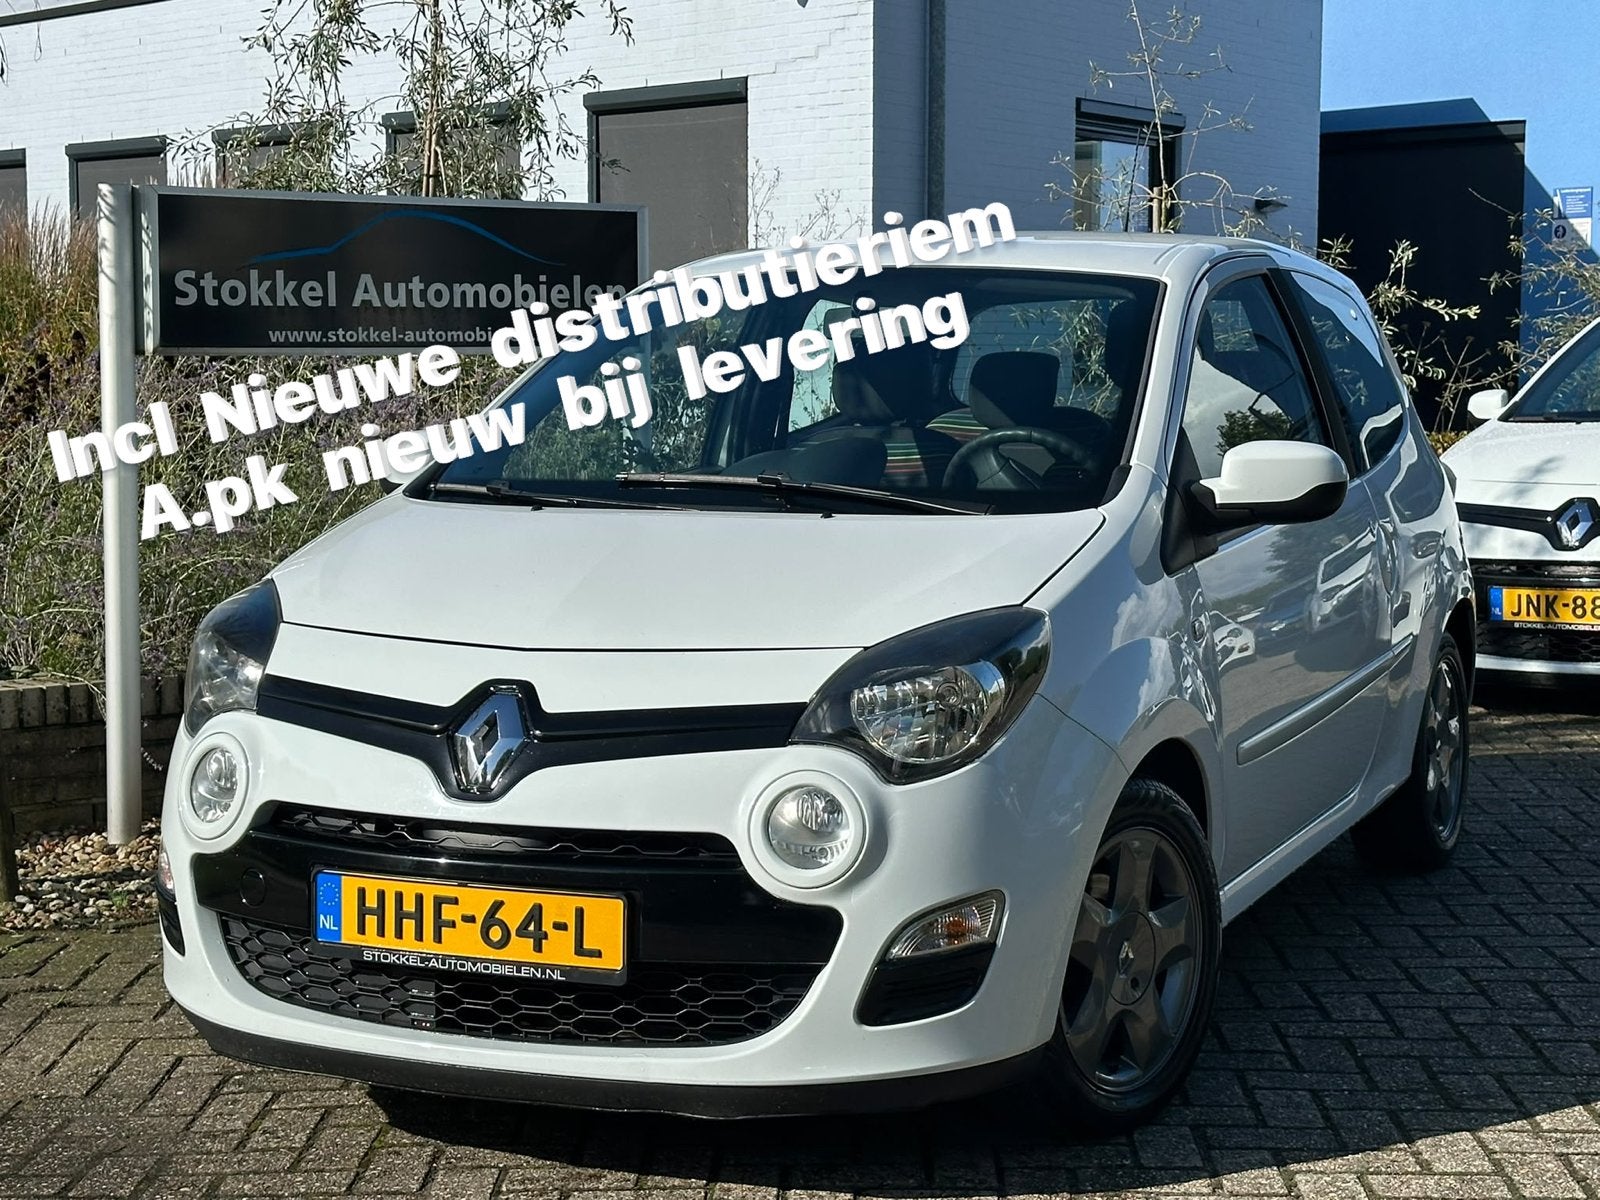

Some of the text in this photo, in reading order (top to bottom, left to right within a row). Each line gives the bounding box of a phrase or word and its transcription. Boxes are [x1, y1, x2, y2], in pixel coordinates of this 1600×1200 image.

[173, 269, 337, 308] Stokkel
[268, 327, 512, 345] www.stokkel-automobi
[1491, 607, 1502, 615] NL
[319, 914, 338, 930] NL
[356, 886, 602, 958] HHF-64-L
[363, 950, 566, 980] STOKKEL-AUTOMOBIELEN.NL
